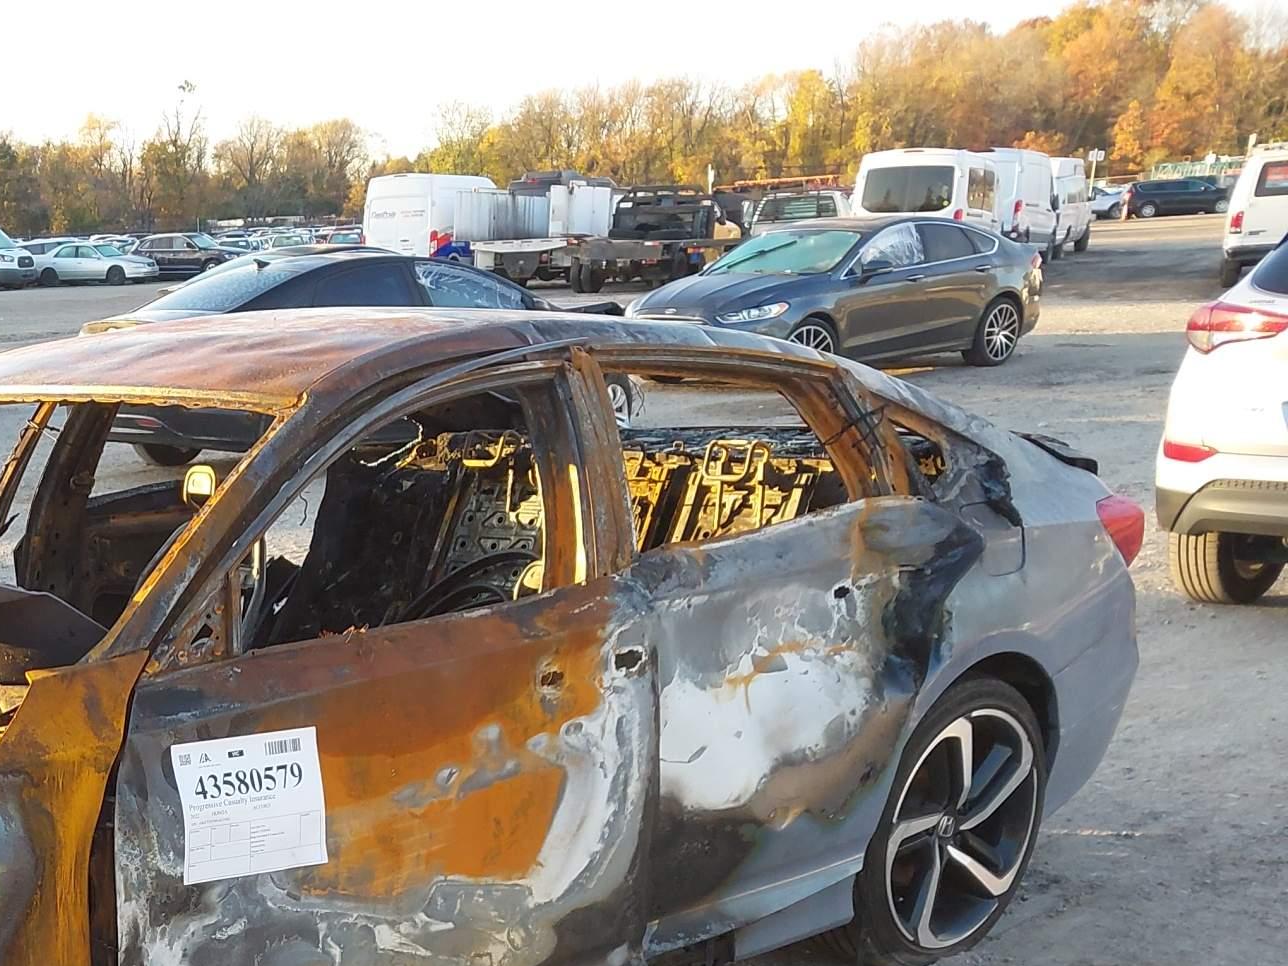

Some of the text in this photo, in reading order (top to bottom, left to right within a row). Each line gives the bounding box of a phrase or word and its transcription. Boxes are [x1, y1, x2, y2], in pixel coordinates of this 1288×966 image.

[194, 762, 303, 800] 43580579
[188, 794, 276, 812] Progressive Casualty Insurance
